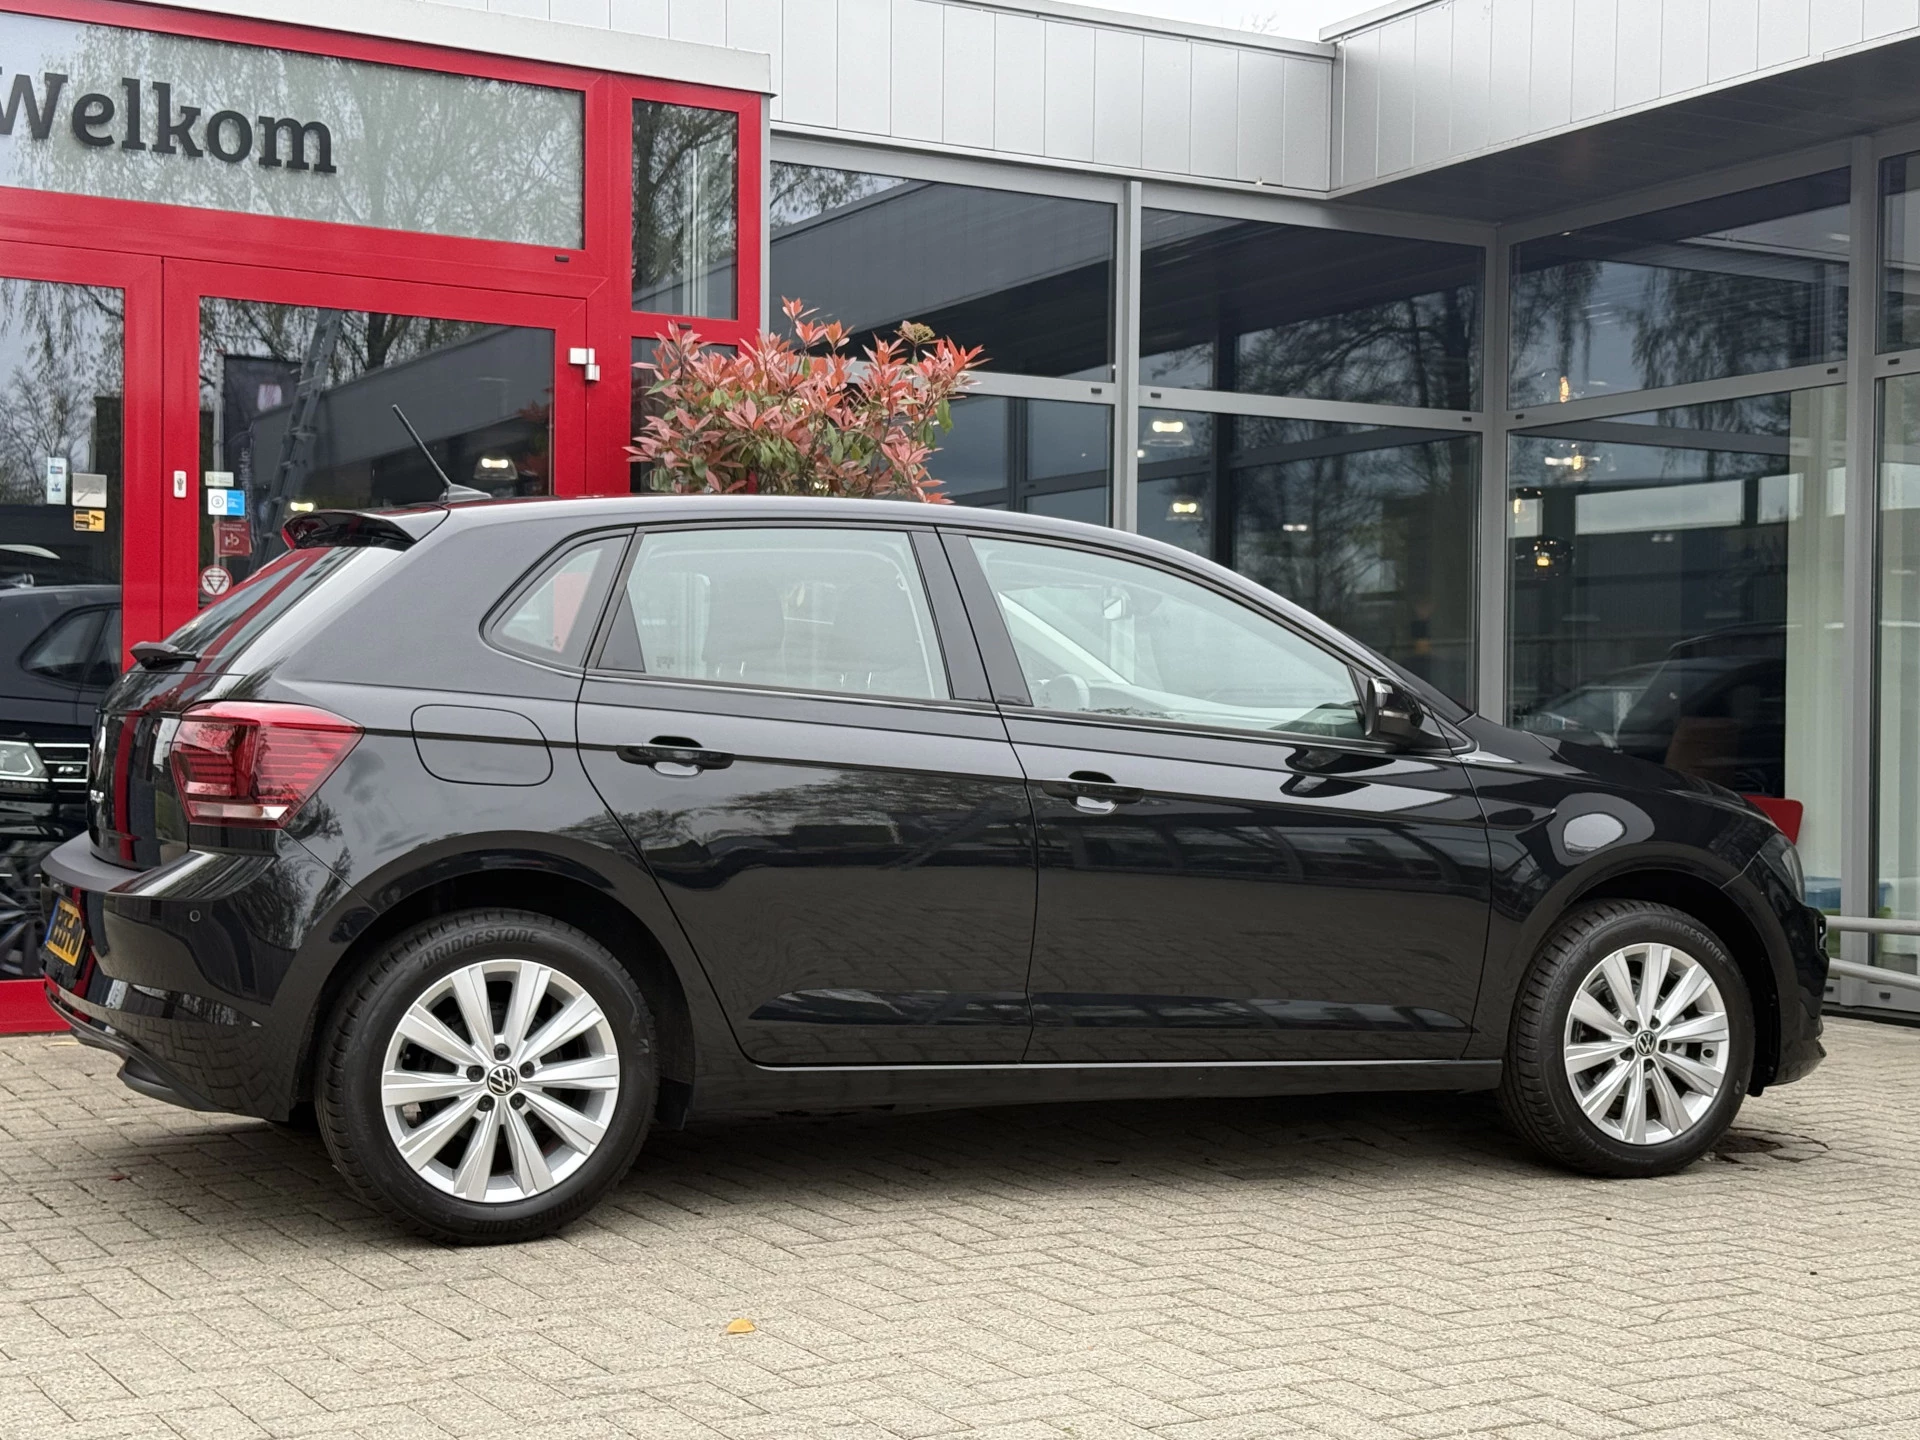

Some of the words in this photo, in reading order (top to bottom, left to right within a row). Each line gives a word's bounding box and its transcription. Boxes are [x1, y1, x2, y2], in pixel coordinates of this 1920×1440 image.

[0, 66, 337, 173] Welkom
[419, 928, 539, 970] BRIDGESTONE
[1650, 916, 1728, 964] BRIDGESTONE
